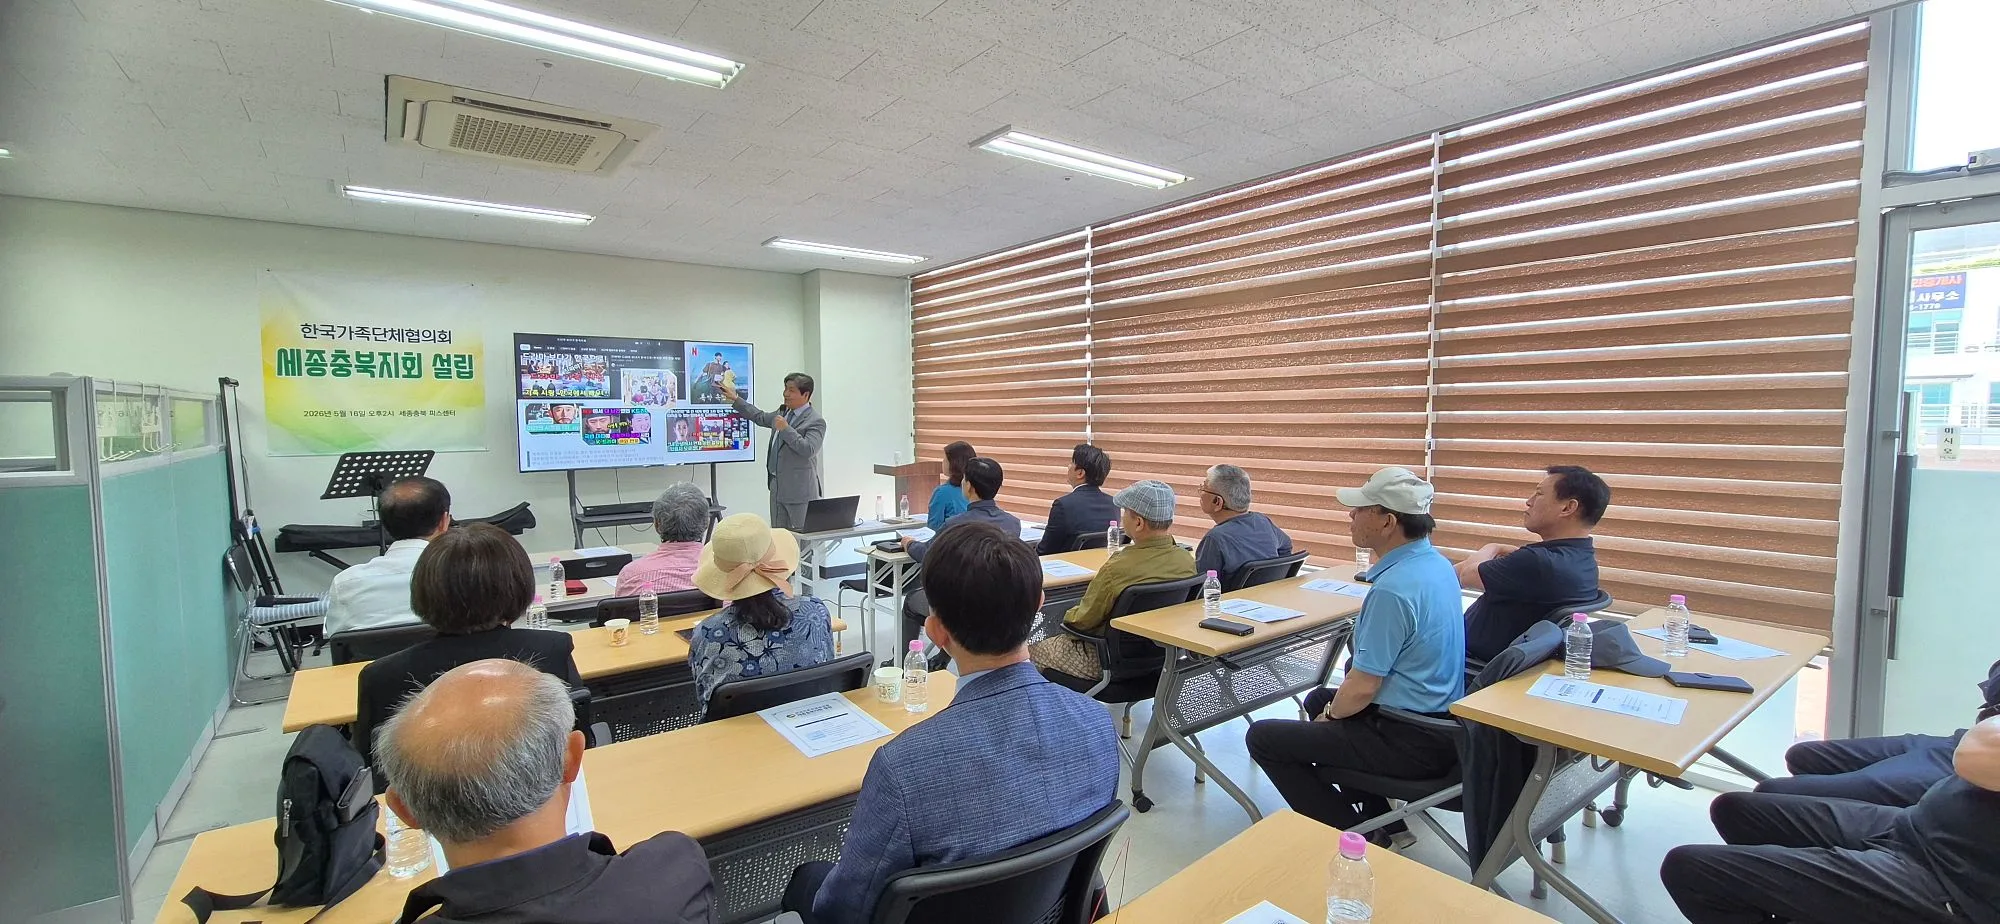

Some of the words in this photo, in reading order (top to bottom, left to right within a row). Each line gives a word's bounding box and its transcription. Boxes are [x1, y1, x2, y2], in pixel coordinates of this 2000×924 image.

[300, 323, 452, 344] 한국가족단체협의회
[276, 348, 423, 379] 세종충북지회
[432, 353, 474, 380] 설립
